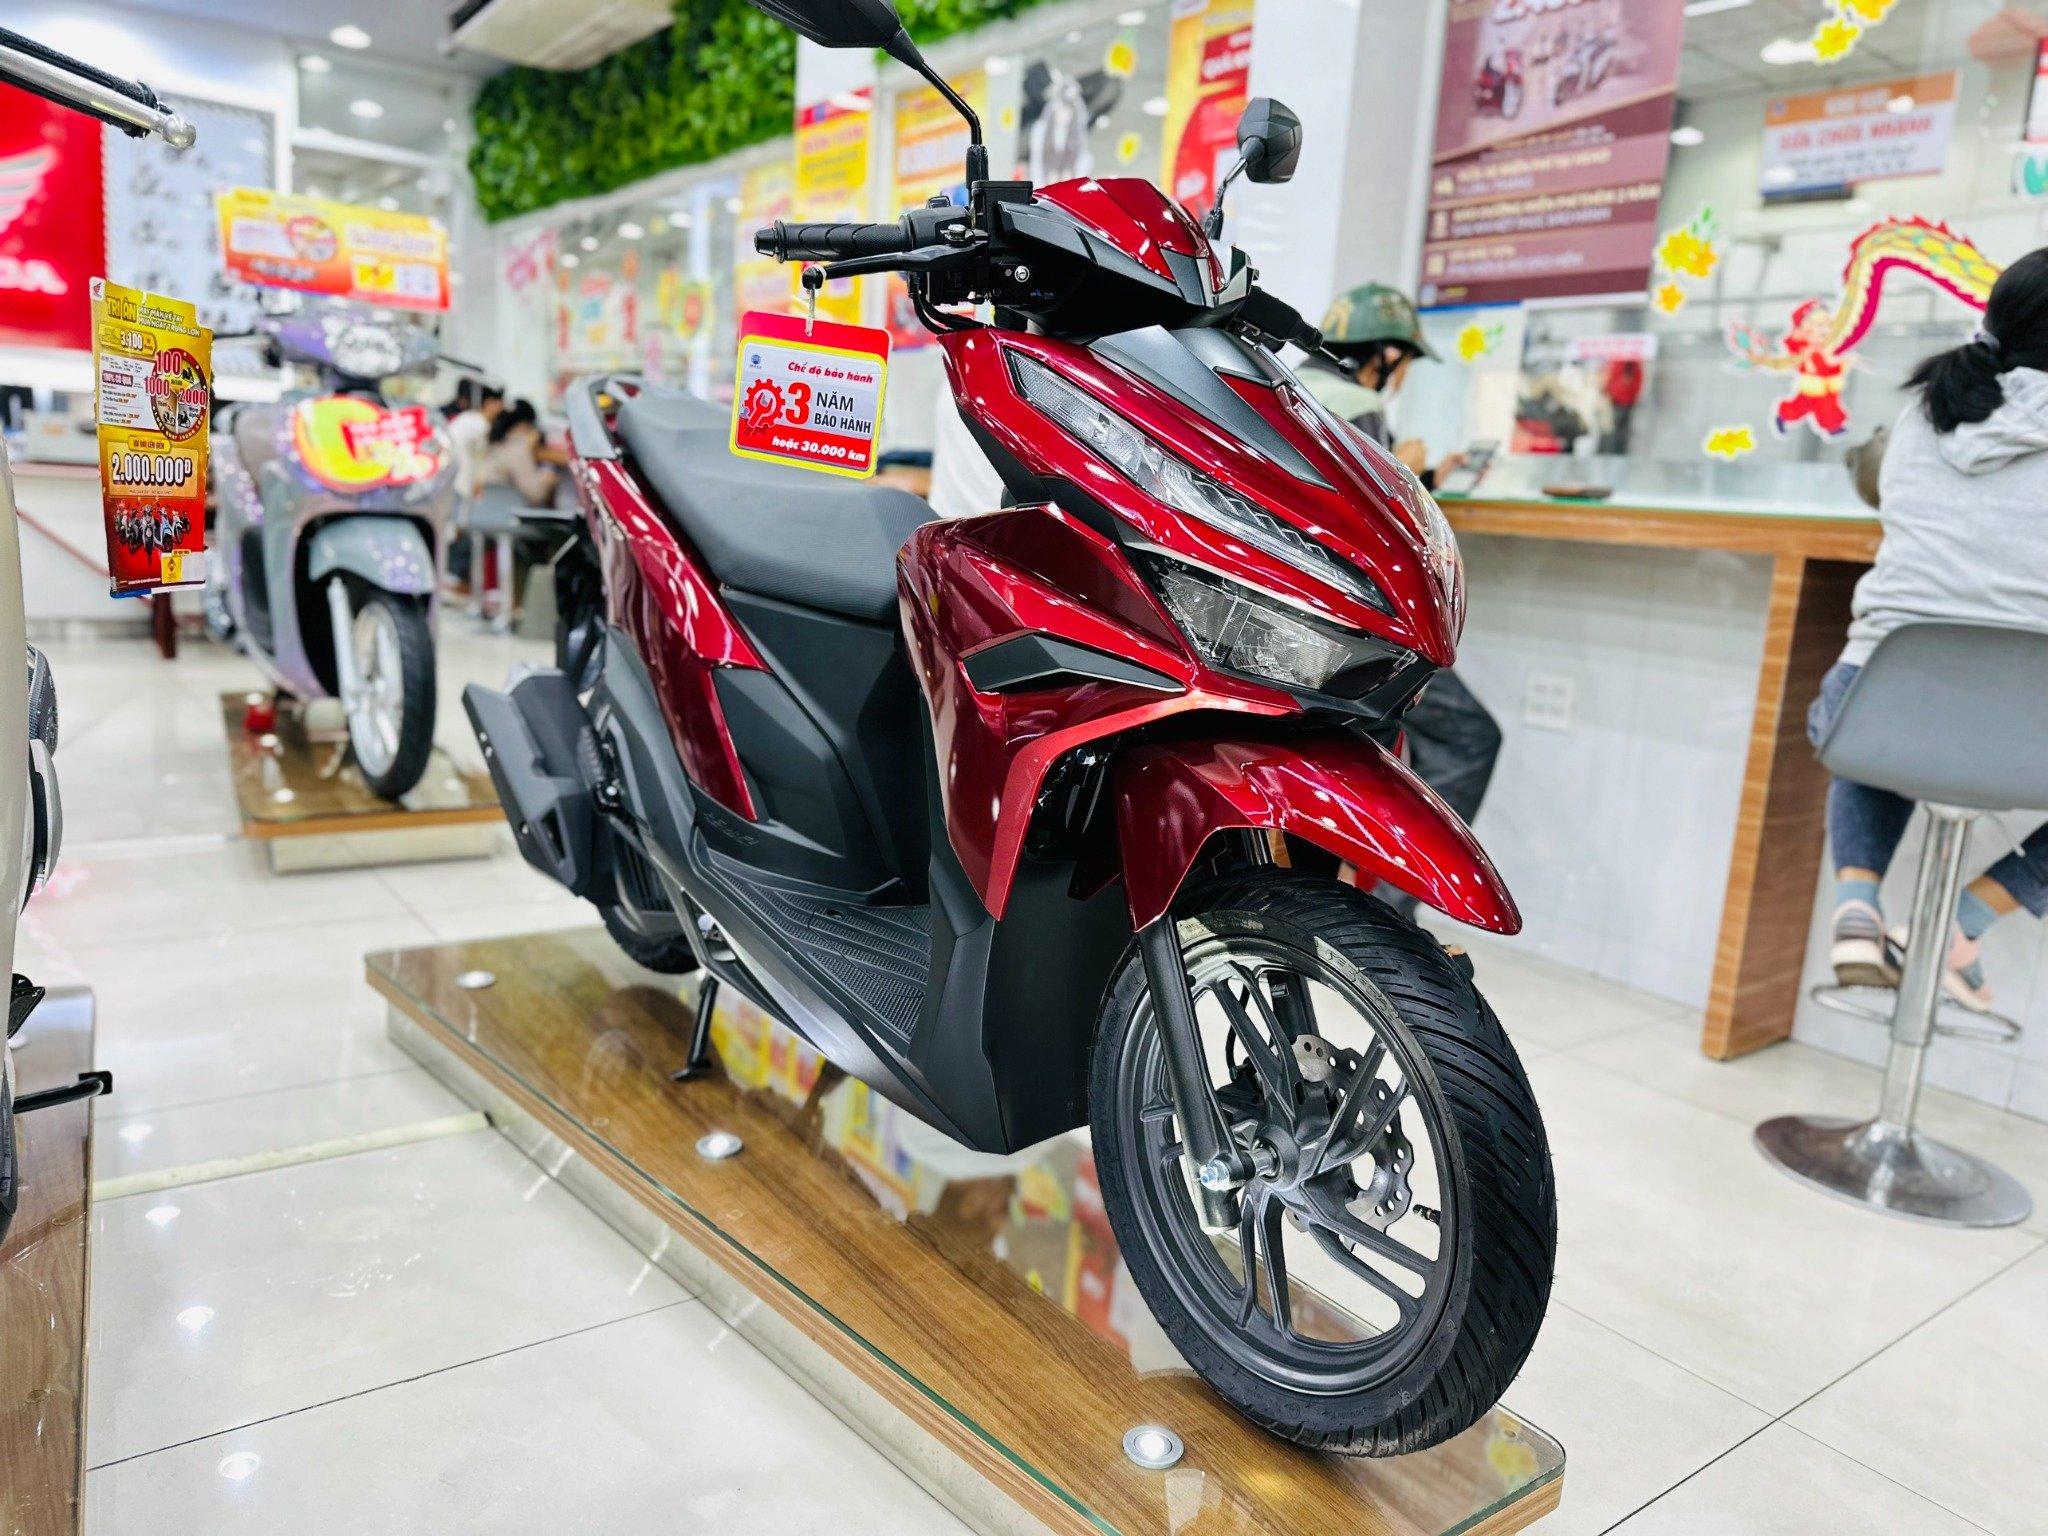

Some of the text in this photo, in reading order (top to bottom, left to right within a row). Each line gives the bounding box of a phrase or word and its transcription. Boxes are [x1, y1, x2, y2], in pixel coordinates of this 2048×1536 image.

[155, 350, 182, 378] 100
[788, 361, 874, 384] Chế độ bảo hành
[144, 375, 170, 399] 1000
[178, 387, 208, 408] 2000
[785, 381, 854, 425] 3 NĂM
[814, 410, 872, 434] BẢO HÀNH
[772, 435, 867, 462] hoặc 30.000 km
